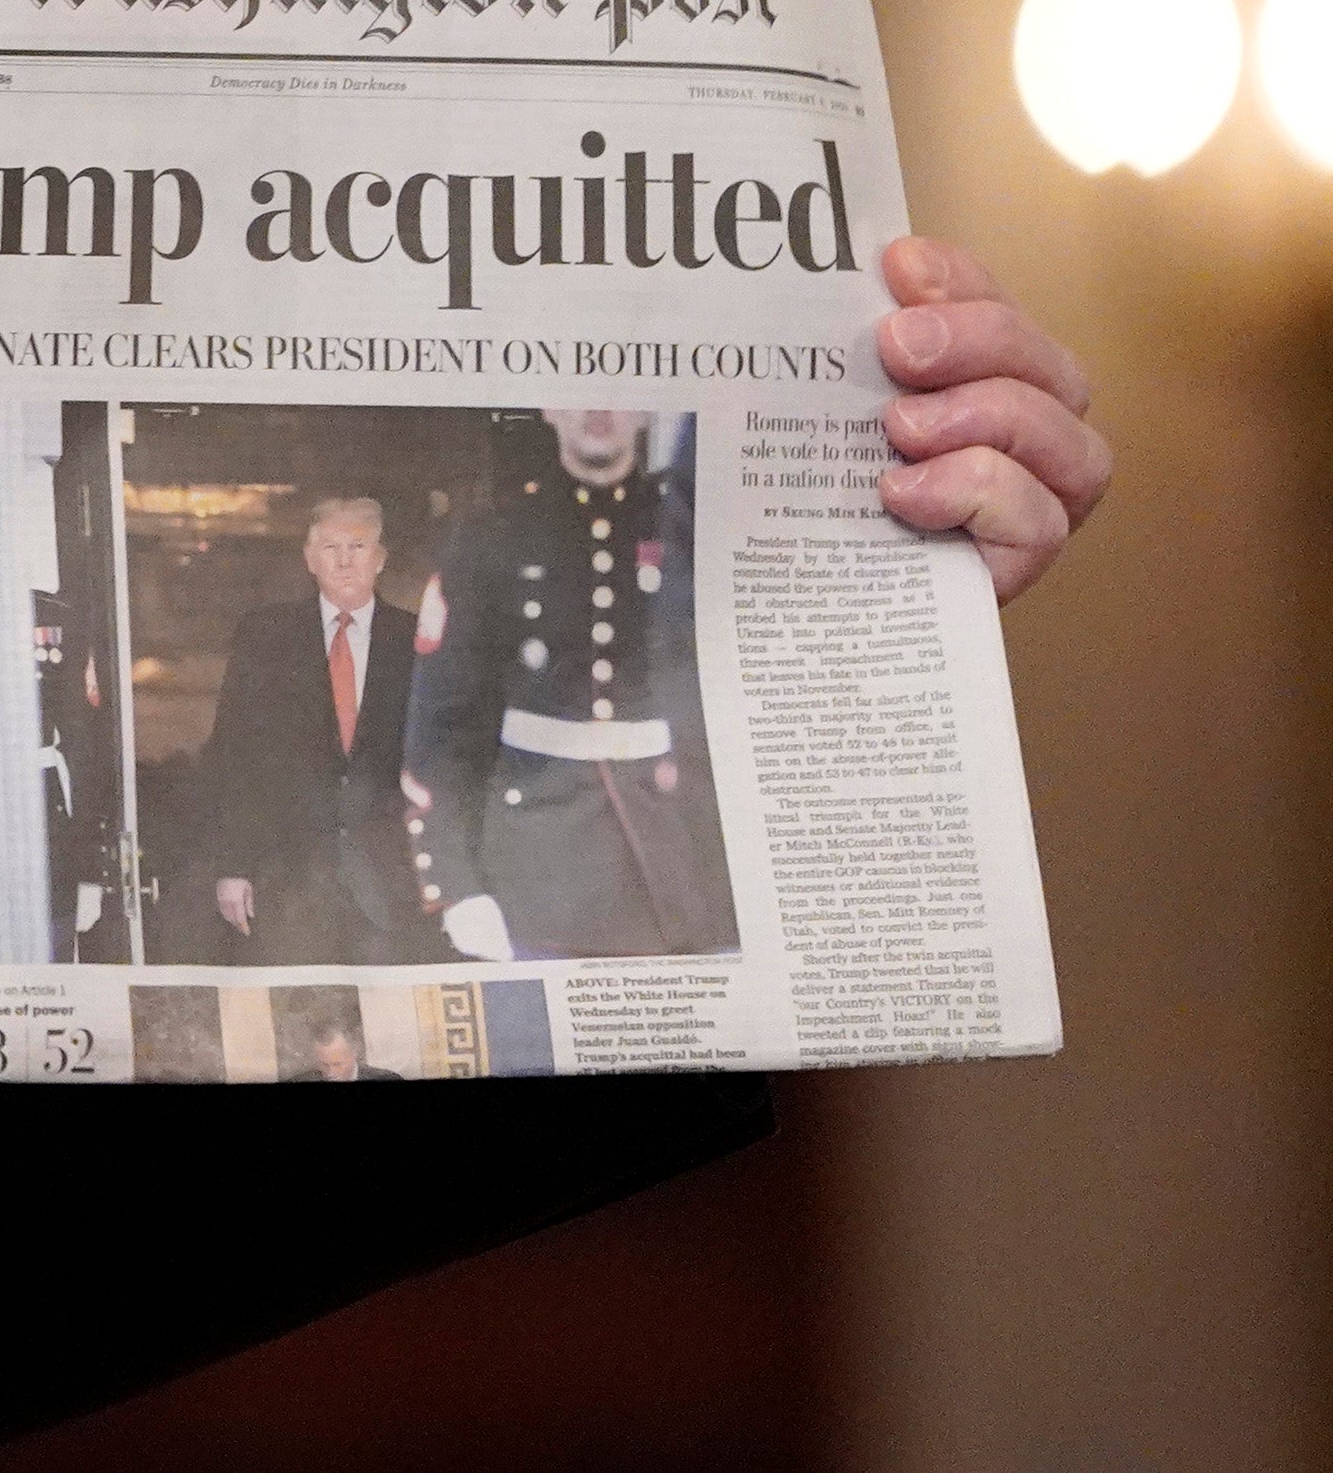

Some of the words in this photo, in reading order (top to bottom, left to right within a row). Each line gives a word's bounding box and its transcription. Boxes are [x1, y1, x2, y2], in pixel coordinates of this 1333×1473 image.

[210, 77, 285, 92] Democracy
[289, 78, 318, 90] Dies
[323, 78, 337, 90] in
[342, 79, 405, 91] Darkness
[245, 130, 863, 310] acquitted
[103, 337, 252, 370] CLEARS
[266, 339, 493, 374] PRESIDENT
[503, 343, 559, 375] ON
[575, 344, 678, 377] BOTH
[691, 346, 849, 380] COUNTS
[746, 412, 816, 438] Romney
[825, 413, 838, 432] is
[741, 441, 775, 460] sole
[782, 441, 815, 460] vote
[822, 441, 839, 460] to
[741, 467, 758, 486] in
[763, 472, 773, 487] a
[779, 468, 834, 487] nation
[840, 469, 883, 488] divid
[566, 976, 617, 987] ABOVE:
[622, 974, 682, 986] President
[687, 973, 728, 987] Trump
[567, 991, 597, 1003] exits
[600, 991, 620, 1002] the
[624, 989, 663, 1001] White
[667, 988, 706, 1000] House
[709, 990, 725, 998] on
[14, 1005, 28, 1015] of
[32, 1007, 73, 1017] power
[569, 1004, 641, 1019] Wednesday
[645, 1003, 658, 1014] to
[661, 1002, 693, 1017] greet
[572, 1019, 644, 1032] Venezuelan
[647, 1016, 714, 1032] opposition
[573, 1036, 612, 1047] leader
[617, 1035, 647, 1046] Juan
[43, 1028, 96, 1075] 52
[576, 1051, 626, 1066] Trump's
[629, 1049, 686, 1064] acquittal
[688, 1048, 713, 1059] had
[715, 1046, 745, 1058] been
